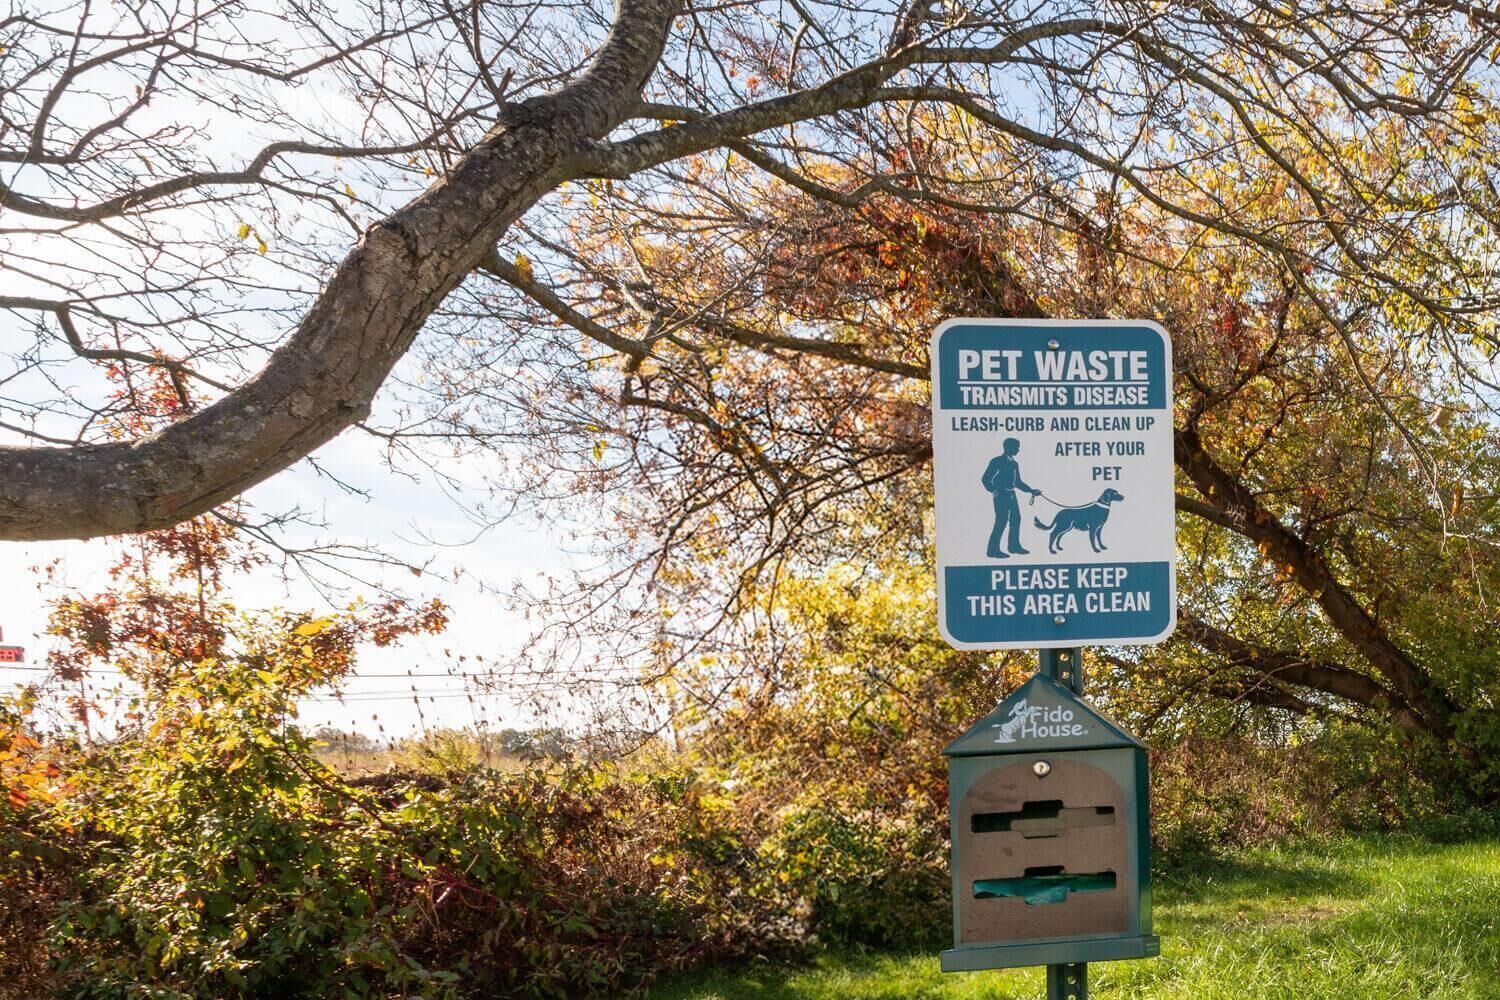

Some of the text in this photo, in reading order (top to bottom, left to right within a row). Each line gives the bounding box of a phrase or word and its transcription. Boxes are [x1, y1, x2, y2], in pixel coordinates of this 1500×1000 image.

[958, 350, 1148, 381] PET WASTE
[960, 385, 1149, 406] TRANSMITS DISEASE
[951, 416, 1155, 432] LEASH-CURB AND CLEAN UP
[1054, 441, 1146, 456] AFTER YOUR
[1092, 466, 1122, 481] PET
[991, 567, 1129, 590] PLEASE KEEP
[967, 591, 1151, 616] THIS AREA CLEAN
[1029, 705, 1074, 724] Fido
